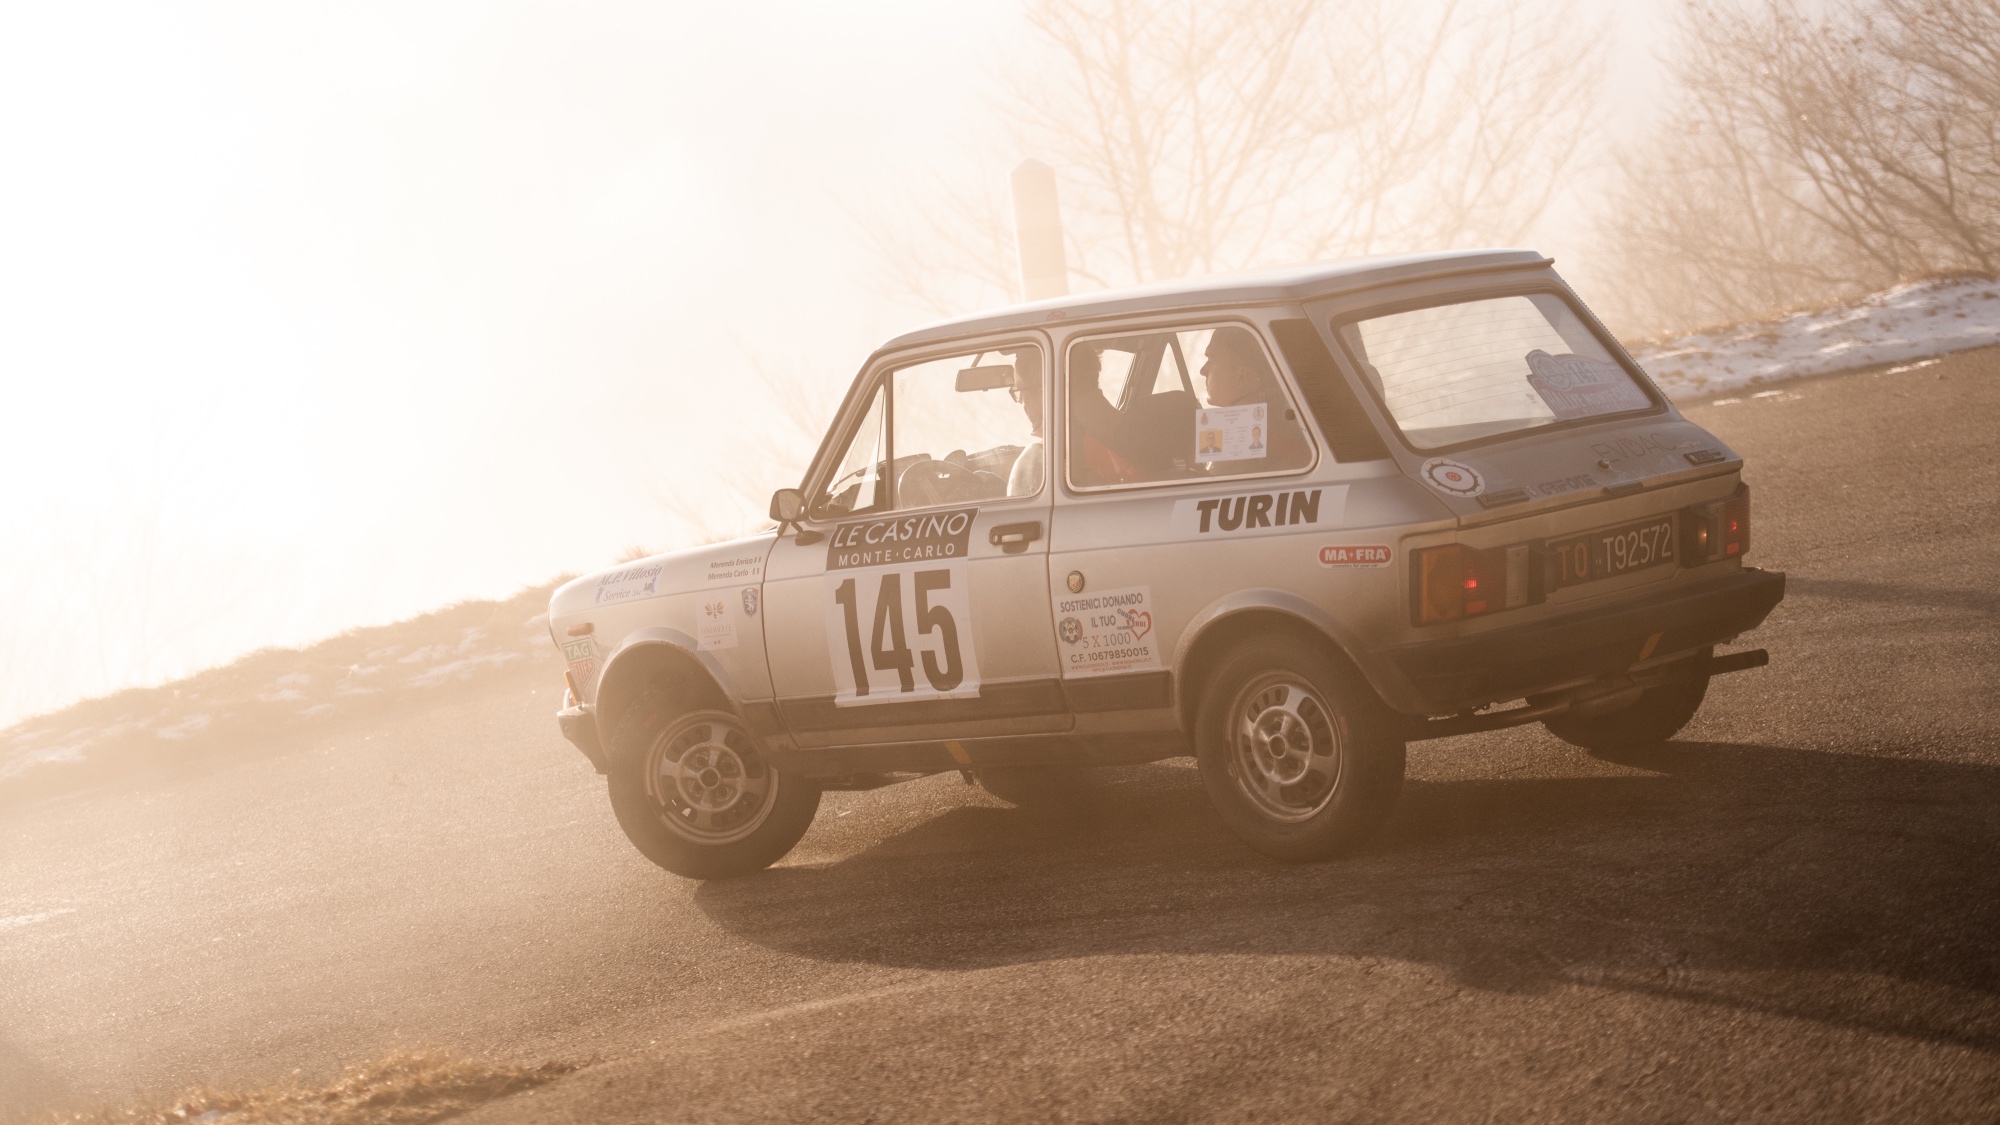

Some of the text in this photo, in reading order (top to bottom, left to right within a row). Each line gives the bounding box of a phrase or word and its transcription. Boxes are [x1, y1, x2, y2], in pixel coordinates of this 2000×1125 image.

[1196, 489, 1322, 534] TURIN
[834, 512, 969, 548] LE CASINO
[1556, 522, 1672, 582] TO T92572
[709, 557, 754, 569] Merenda Enrico
[622, 564, 663, 582] Villosio
[707, 568, 749, 581] Merenda Carlo
[603, 588, 632, 602] Service
[1060, 592, 1143, 613] SOSTIENICI DONANDO
[1091, 614, 1116, 629] IL TUO
[835, 568, 964, 697] 145
[1082, 636, 1090, 649] 5
[1102, 631, 1131, 647] 1000
[565, 643, 590, 659] TAG
[1070, 646, 1149, 663] C.F. 10679850015
